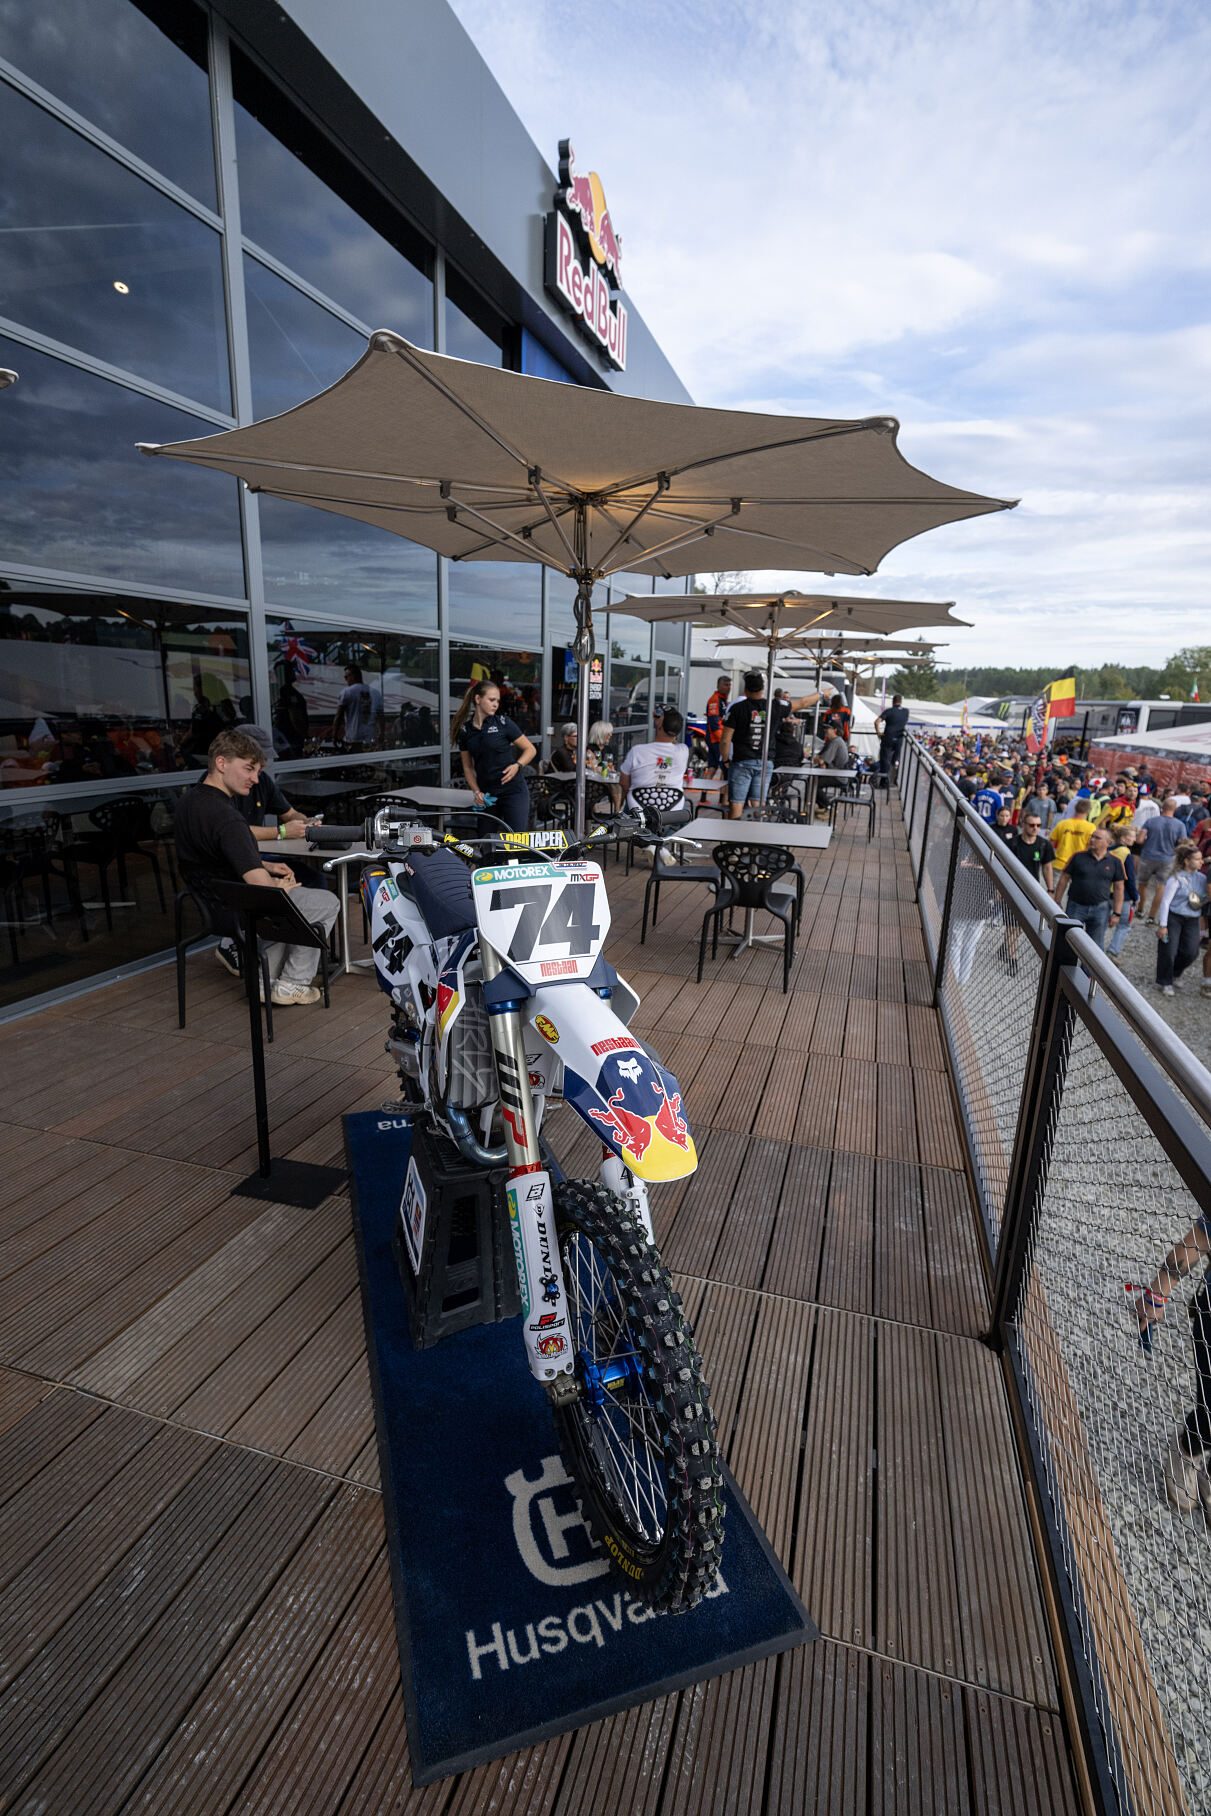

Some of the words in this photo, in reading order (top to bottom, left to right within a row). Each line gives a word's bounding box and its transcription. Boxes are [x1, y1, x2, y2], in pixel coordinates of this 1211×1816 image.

[977, 801, 992, 817] 10
[506, 831, 563, 849] PROTAPER
[494, 865, 550, 881] MOTOREX
[570, 873, 600, 882] MXGP
[489, 883, 600, 962] 74
[372, 911, 414, 975] 74
[540, 959, 579, 977] nestaan
[535, 1015, 560, 1044] FMF
[510, 1220, 529, 1307] MOTOREX
[604, 1535, 642, 1580] DUNLOP
[465, 1568, 729, 1680] Husqvaa
